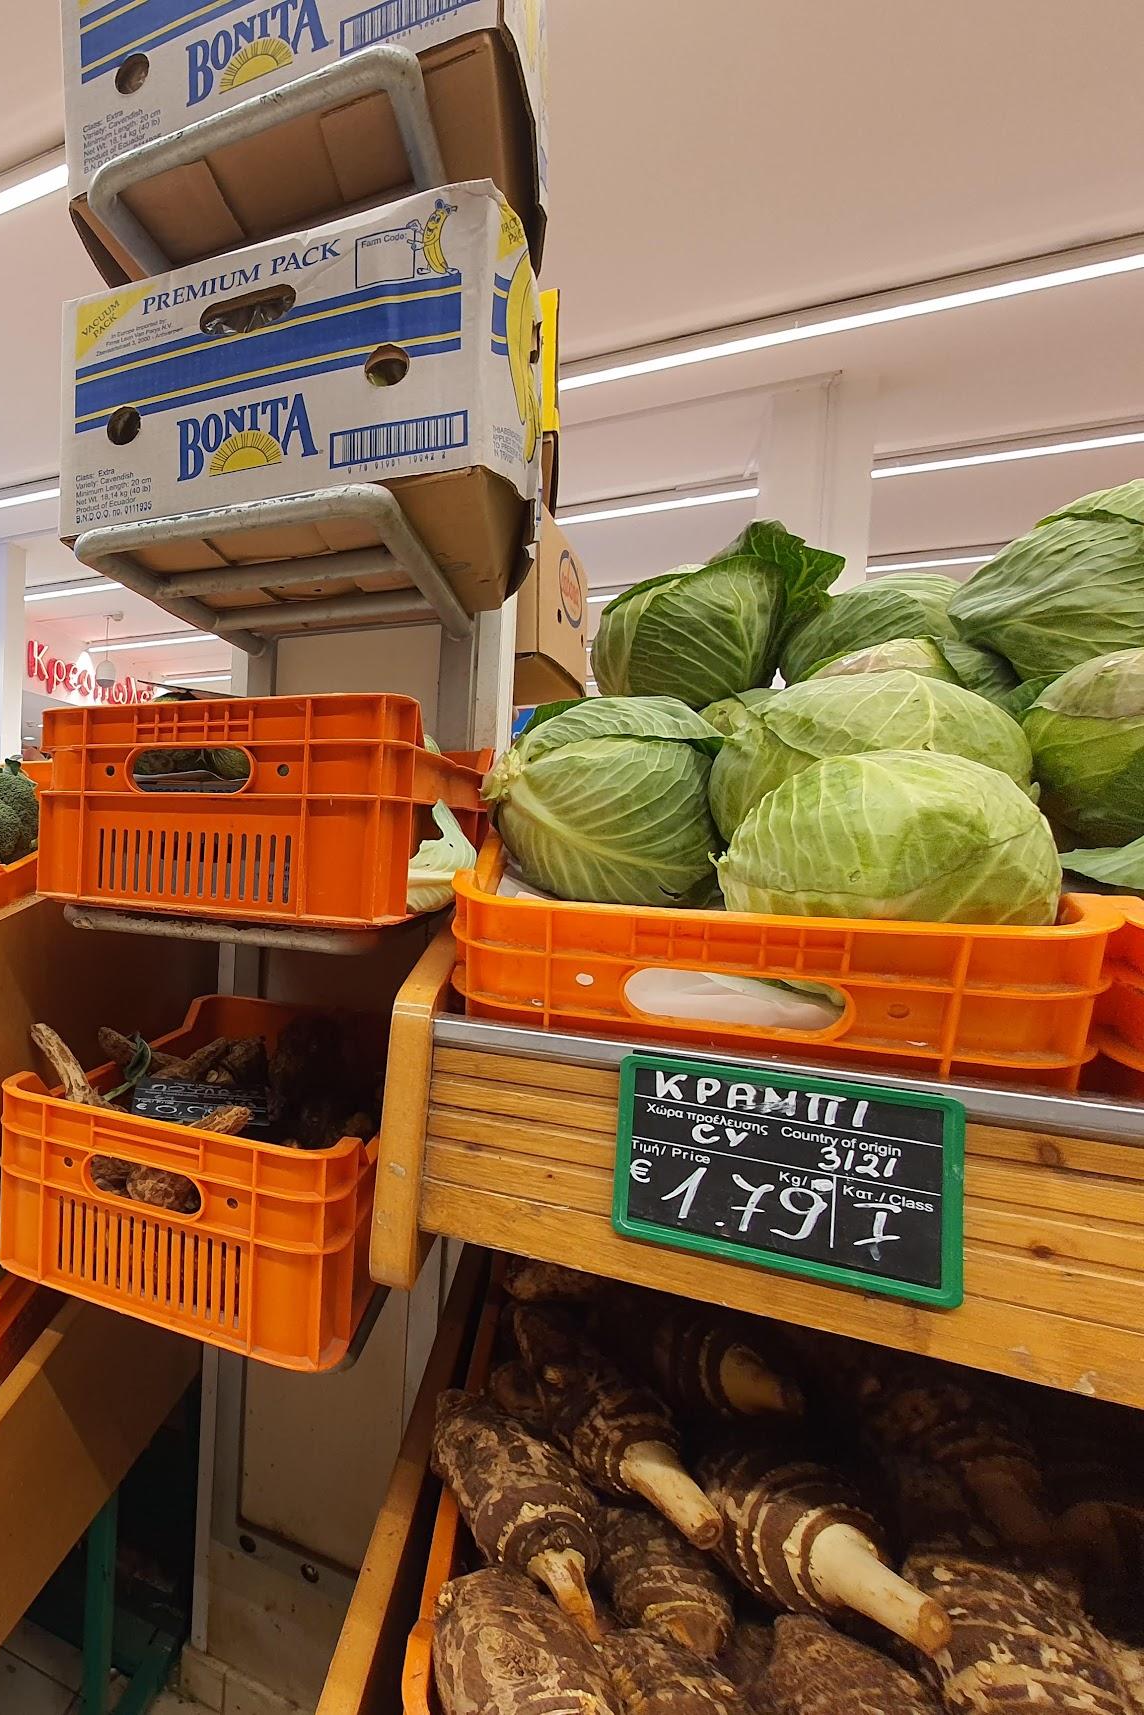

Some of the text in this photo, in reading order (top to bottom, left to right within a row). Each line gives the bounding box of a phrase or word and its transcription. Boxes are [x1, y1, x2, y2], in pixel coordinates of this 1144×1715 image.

[186, 0, 330, 107] BONITA
[361, 233, 408, 249] Farm Code:
[142, 239, 341, 316] PREMIUM PACK
[82, 299, 121, 337] VACUUM
[92, 313, 118, 339] PACK
[177, 393, 319, 482] BONITA
[98, 468, 115, 477] Extra
[100, 472, 134, 485] Cavendish
[76, 487, 104, 498] Minimum
[131, 478, 140, 486] 20
[76, 498, 87, 506] Net
[129, 486, 140, 496] (40
[76, 503, 100, 513] Product
[108, 496, 137, 508] Ecuador
[646, 1102, 769, 1136] Χώρα προέλευσης
[691, 1123, 897, 1178] CY 3121
[781, 1126, 902, 1157] Country of origin
[671, 1147, 711, 1164] Price
[629, 1158, 652, 1183] €
[888, 1194, 934, 1212] Class
